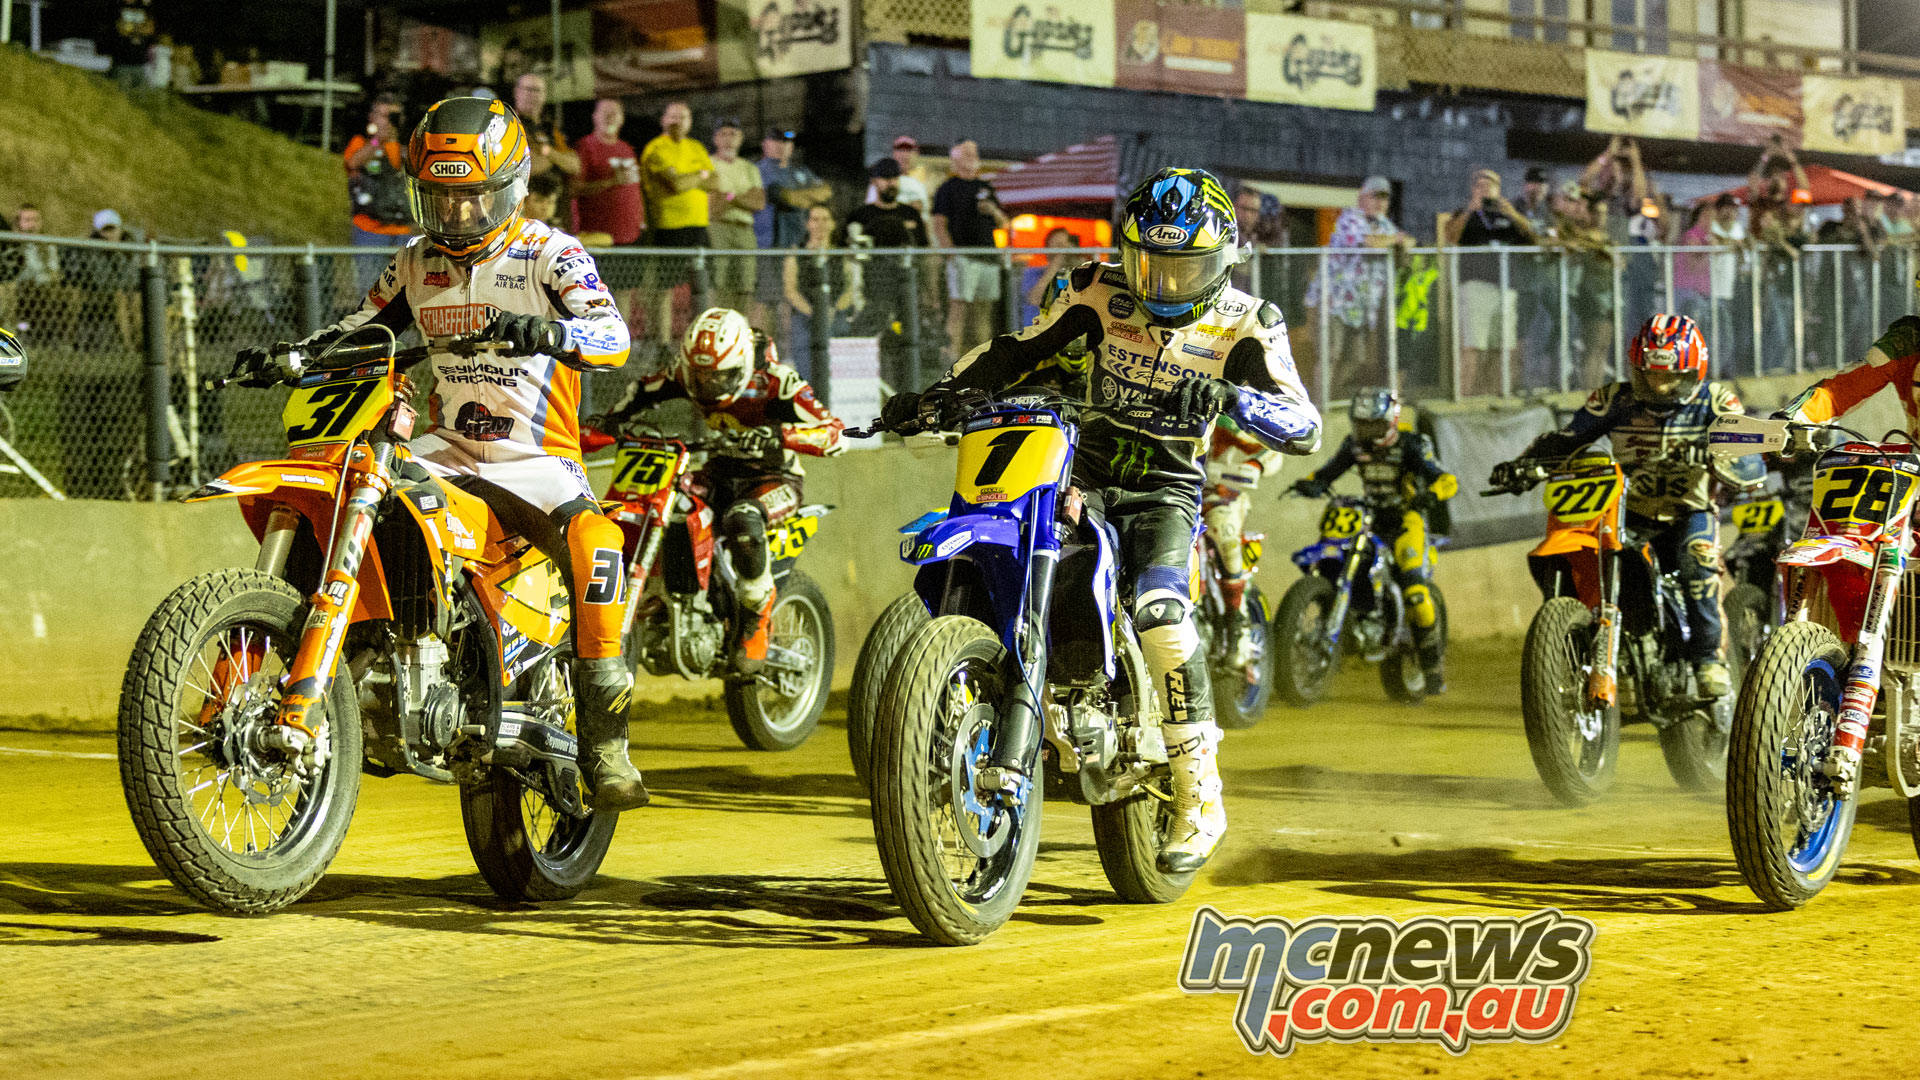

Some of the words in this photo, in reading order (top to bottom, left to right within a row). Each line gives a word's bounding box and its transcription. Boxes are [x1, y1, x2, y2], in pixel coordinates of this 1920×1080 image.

[434, 164, 466, 175] SHOEI
[1150, 226, 1183, 241] Arai
[509, 282, 526, 290] BAG
[1220, 301, 1243, 312] Arai
[438, 363, 529, 377] SEYMOUR
[1108, 344, 1212, 379] ESTENSON
[445, 374, 518, 388] RACING
[287, 379, 381, 442] 31
[615, 450, 675, 486] 75
[974, 430, 1037, 487] 1
[1552, 479, 1617, 516] 227
[1820, 467, 1913, 525] 28
[1321, 508, 1360, 534] 83
[1741, 505, 1774, 528] 21
